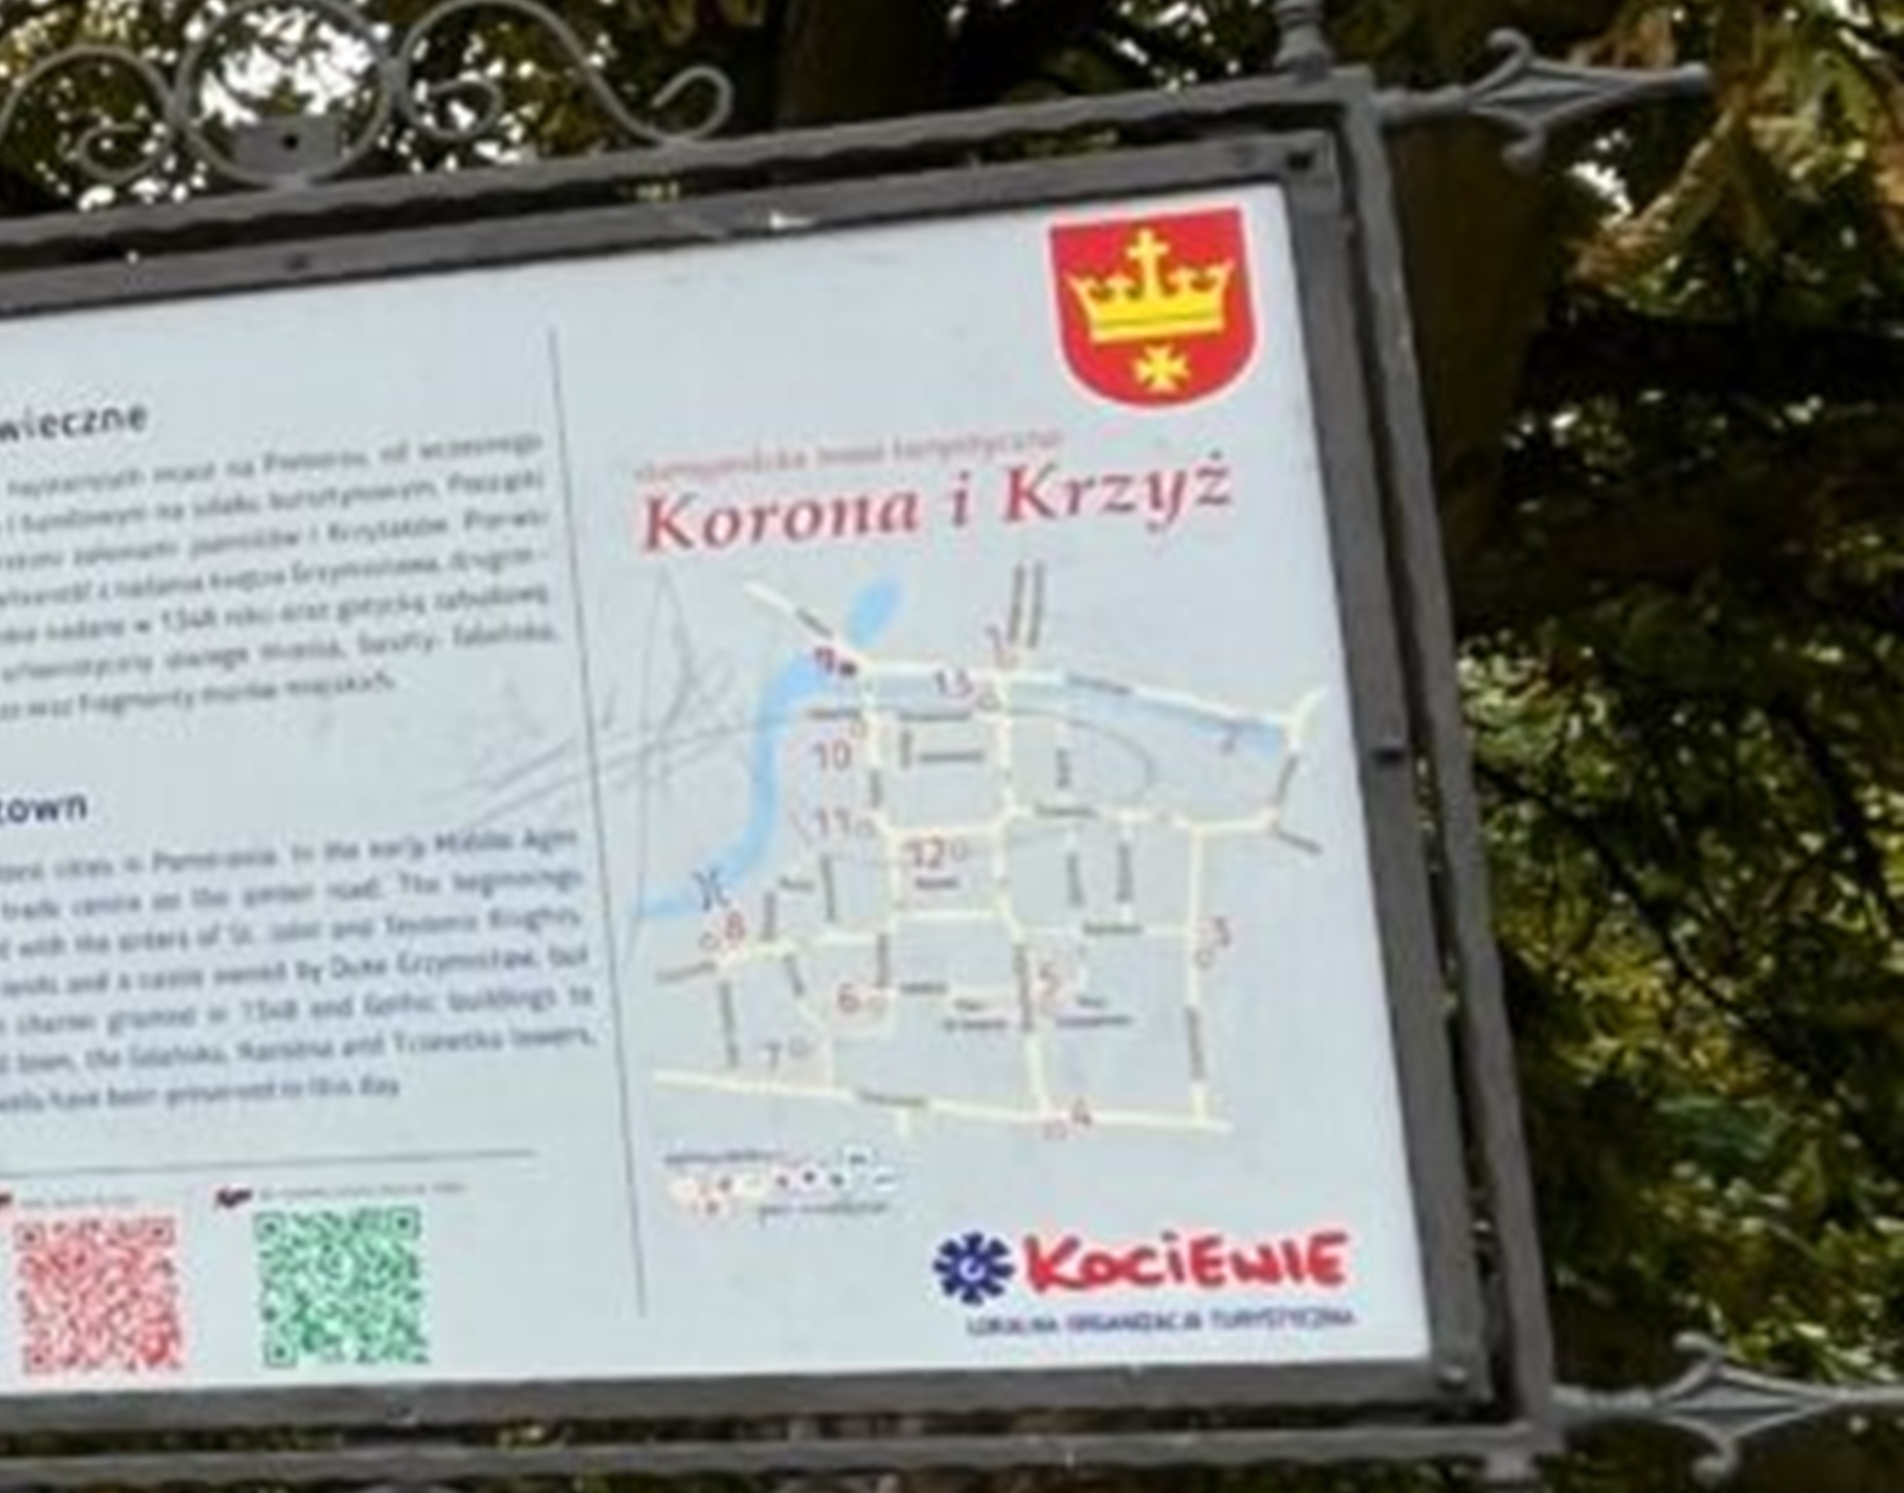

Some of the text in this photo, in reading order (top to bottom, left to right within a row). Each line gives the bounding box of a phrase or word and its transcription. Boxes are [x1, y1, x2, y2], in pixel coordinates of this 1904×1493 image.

[645, 450, 1234, 553] Korona i Krzyż
